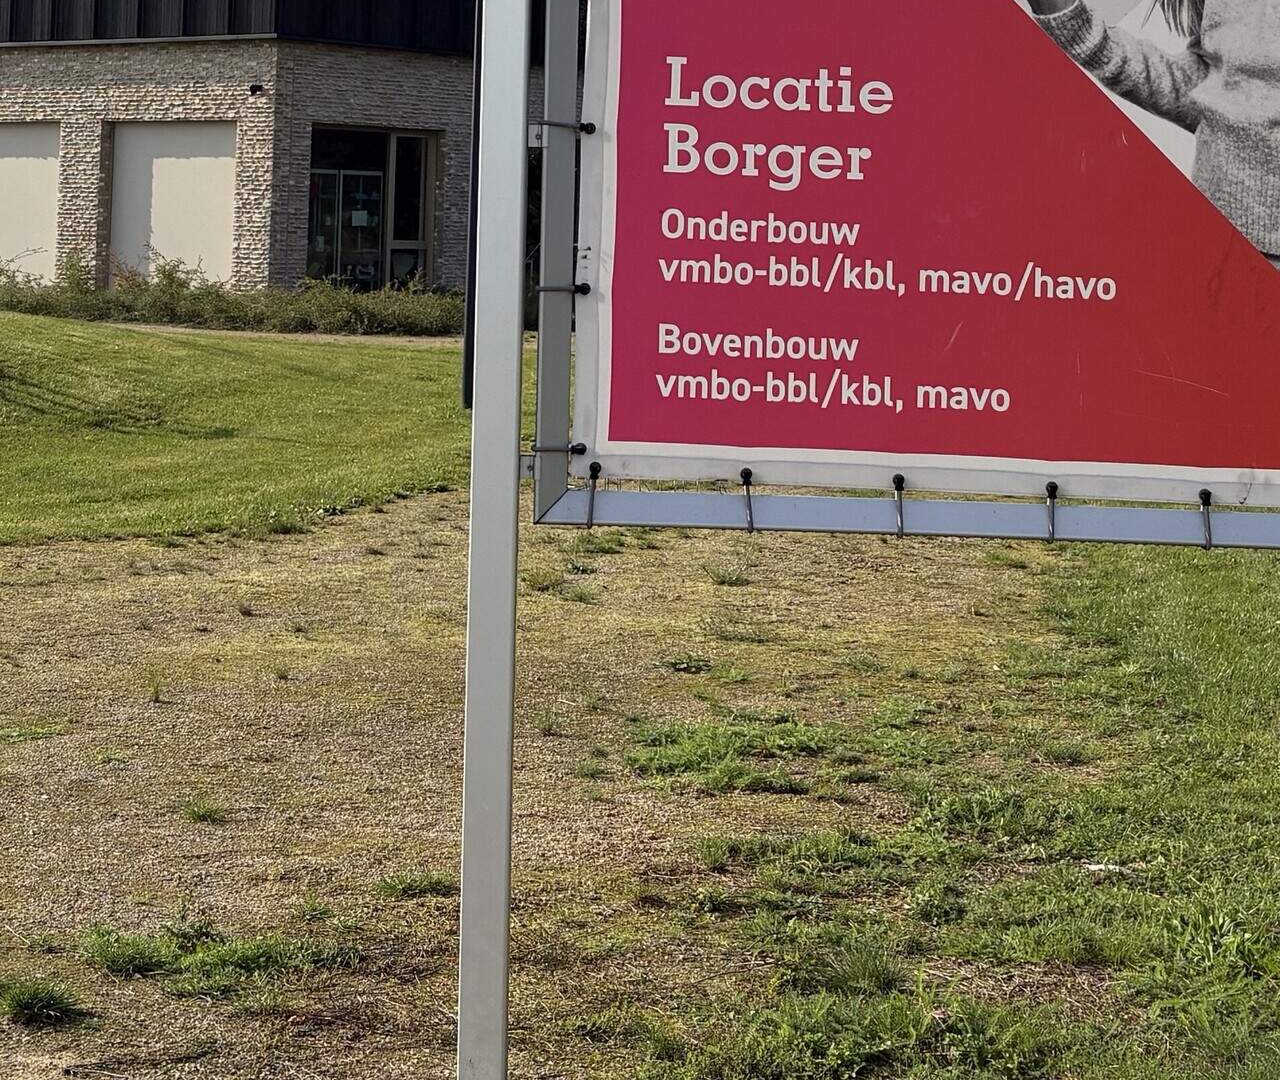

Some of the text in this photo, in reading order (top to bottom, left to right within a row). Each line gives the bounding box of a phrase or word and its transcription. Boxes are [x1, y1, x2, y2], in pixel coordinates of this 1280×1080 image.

[664, 55, 894, 114] Locatie
[663, 122, 872, 192] Borger
[660, 207, 861, 246] Onderbouw
[658, 252, 1118, 302] vmbo-bbl/kbl, mavo/havo
[657, 322, 860, 361] Bovenbouw
[655, 368, 1011, 414] vmbo-bbl/kbl, mavo
